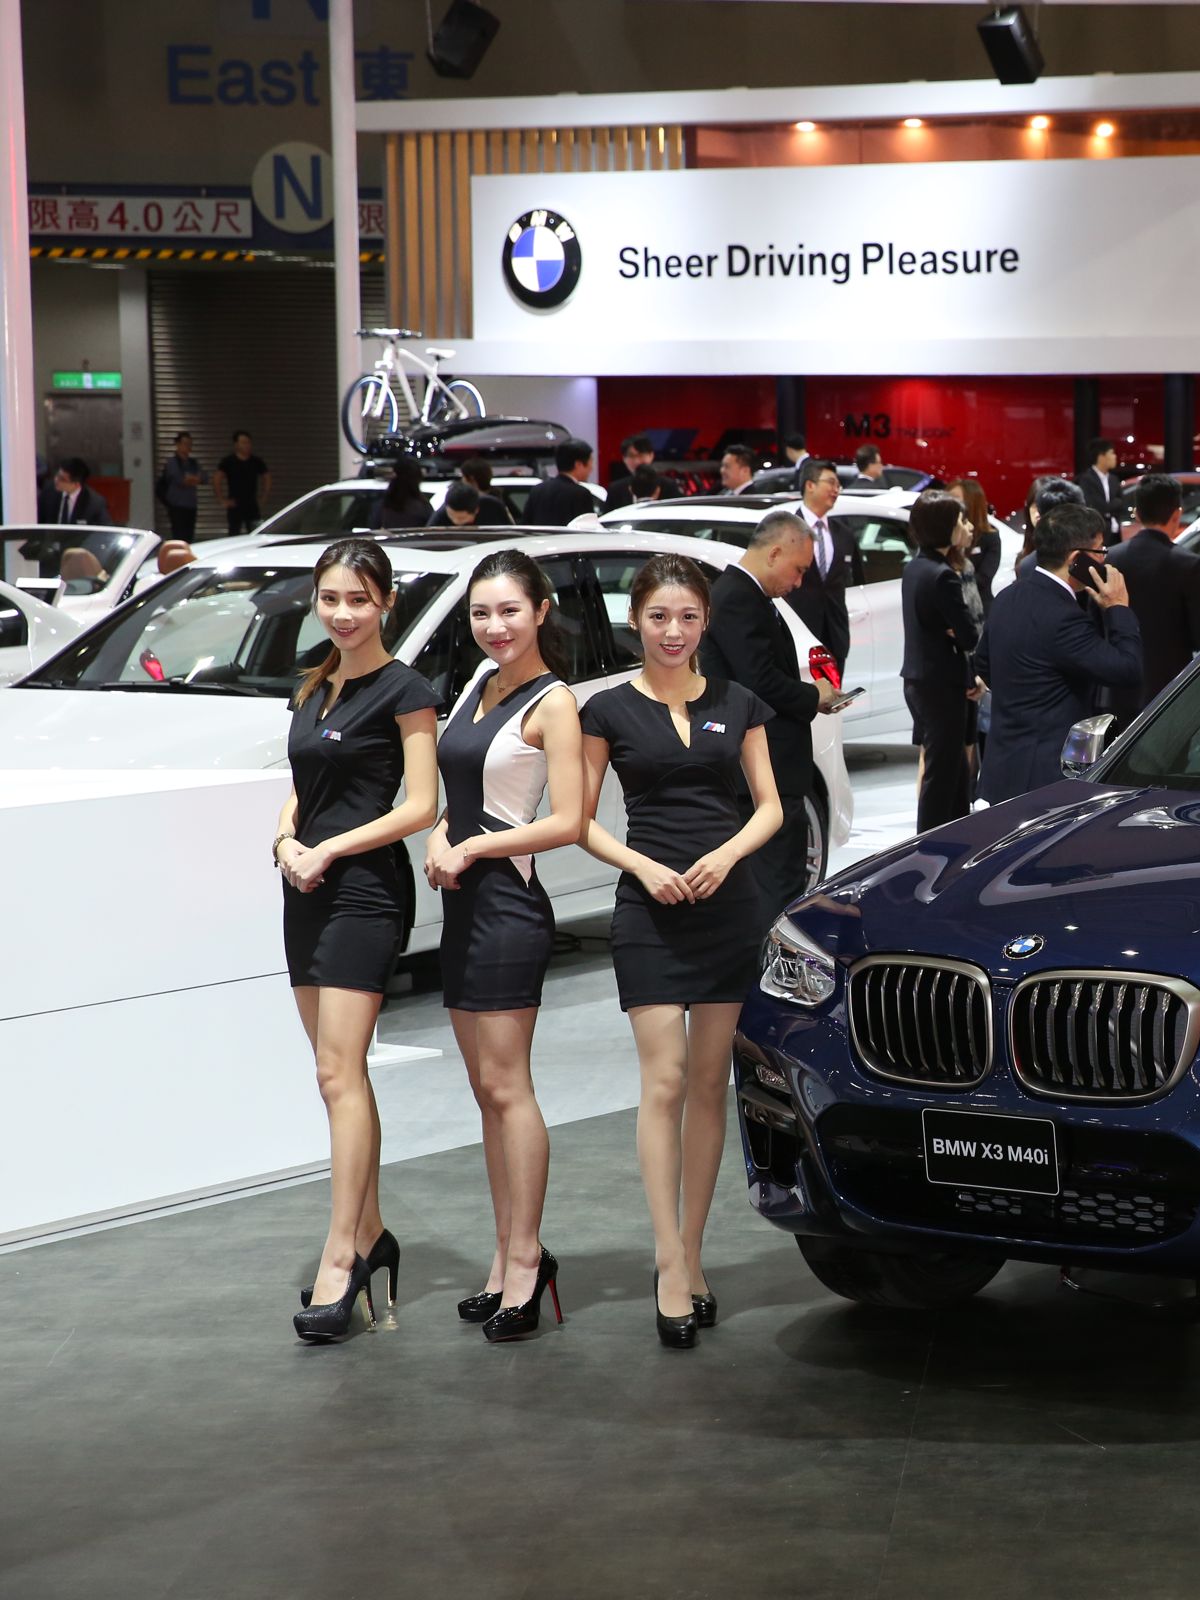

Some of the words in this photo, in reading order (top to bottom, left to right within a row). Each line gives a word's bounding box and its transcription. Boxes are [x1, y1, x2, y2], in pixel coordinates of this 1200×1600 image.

[166, 45, 320, 107] East
[354, 45, 415, 100] 東
[273, 155, 322, 221] N
[618, 247, 719, 279] Sheer
[727, 244, 850, 285] Driving
[862, 242, 1020, 275] Pleasure
[844, 413, 891, 439] M3
[932, 1138, 977, 1158] BMW
[981, 1142, 1004, 1161] X3
[1007, 1145, 1049, 1165] M40i
